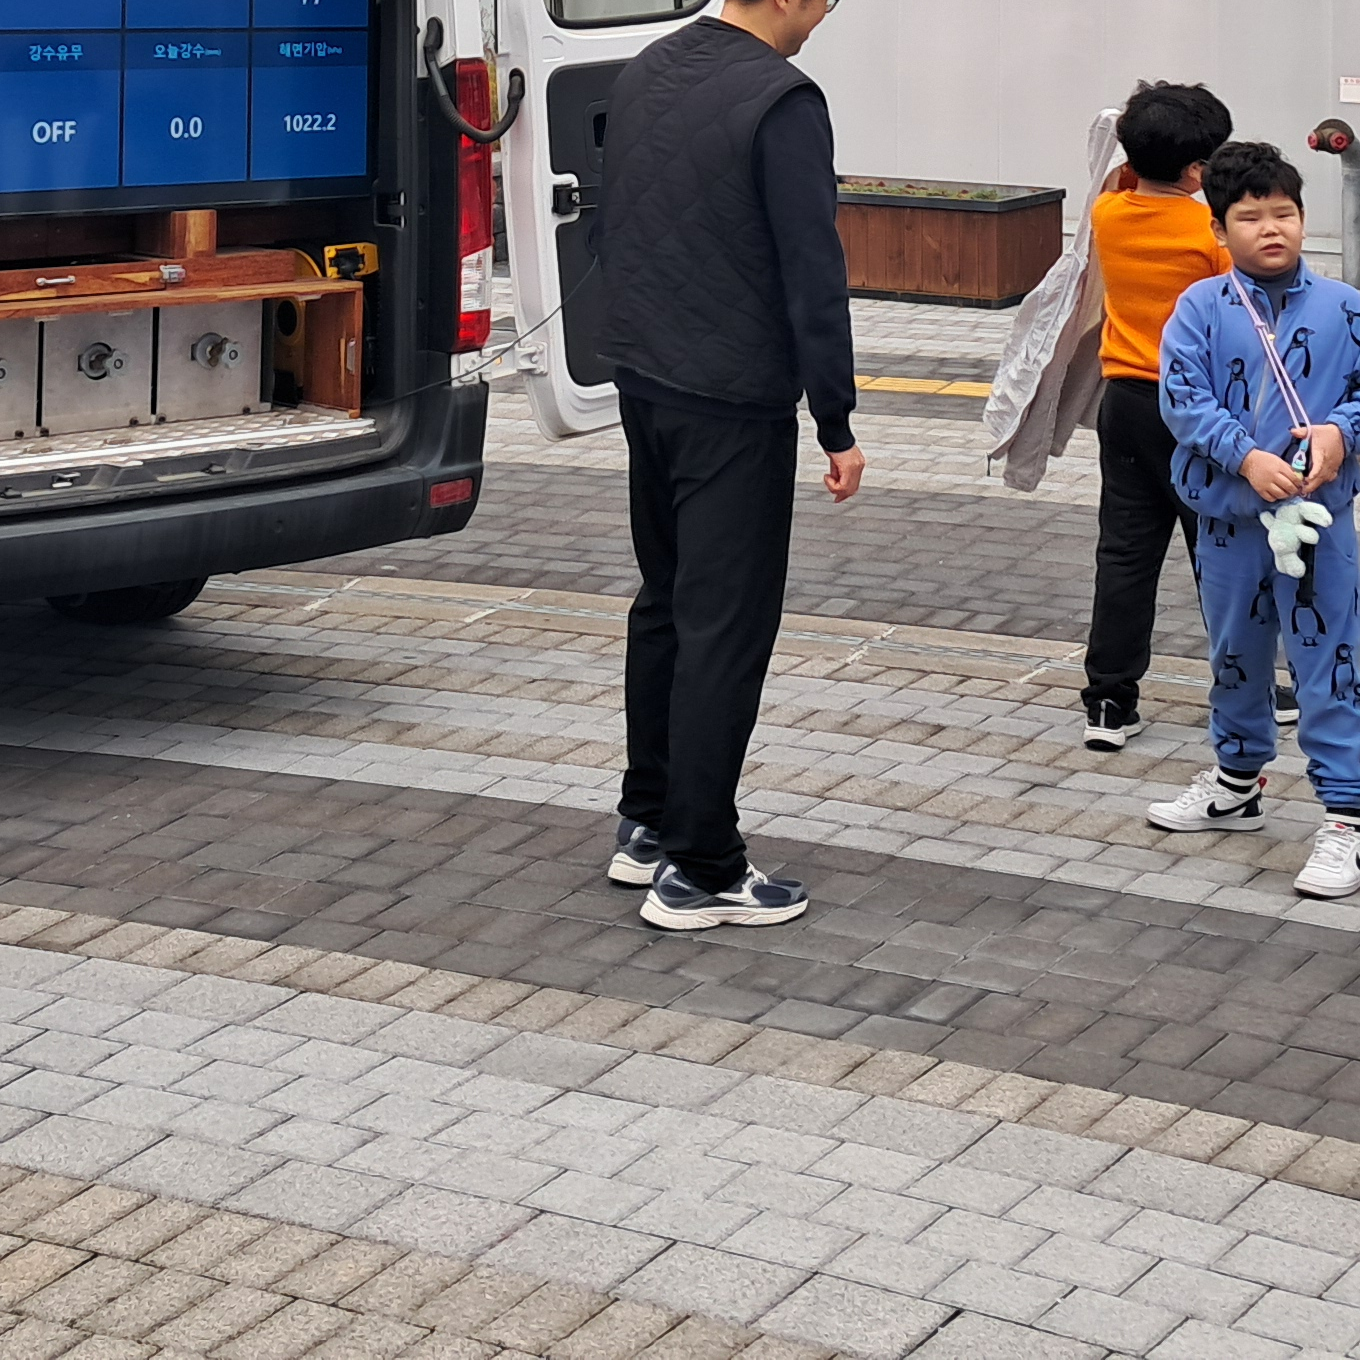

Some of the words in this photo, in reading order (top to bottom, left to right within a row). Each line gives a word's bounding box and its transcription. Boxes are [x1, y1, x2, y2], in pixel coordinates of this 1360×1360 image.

[29, 44, 83, 61] 강수유무
[32, 121, 77, 144] OFF
[170, 116, 203, 138] 0.0
[283, 114, 337, 132] 1022.2
